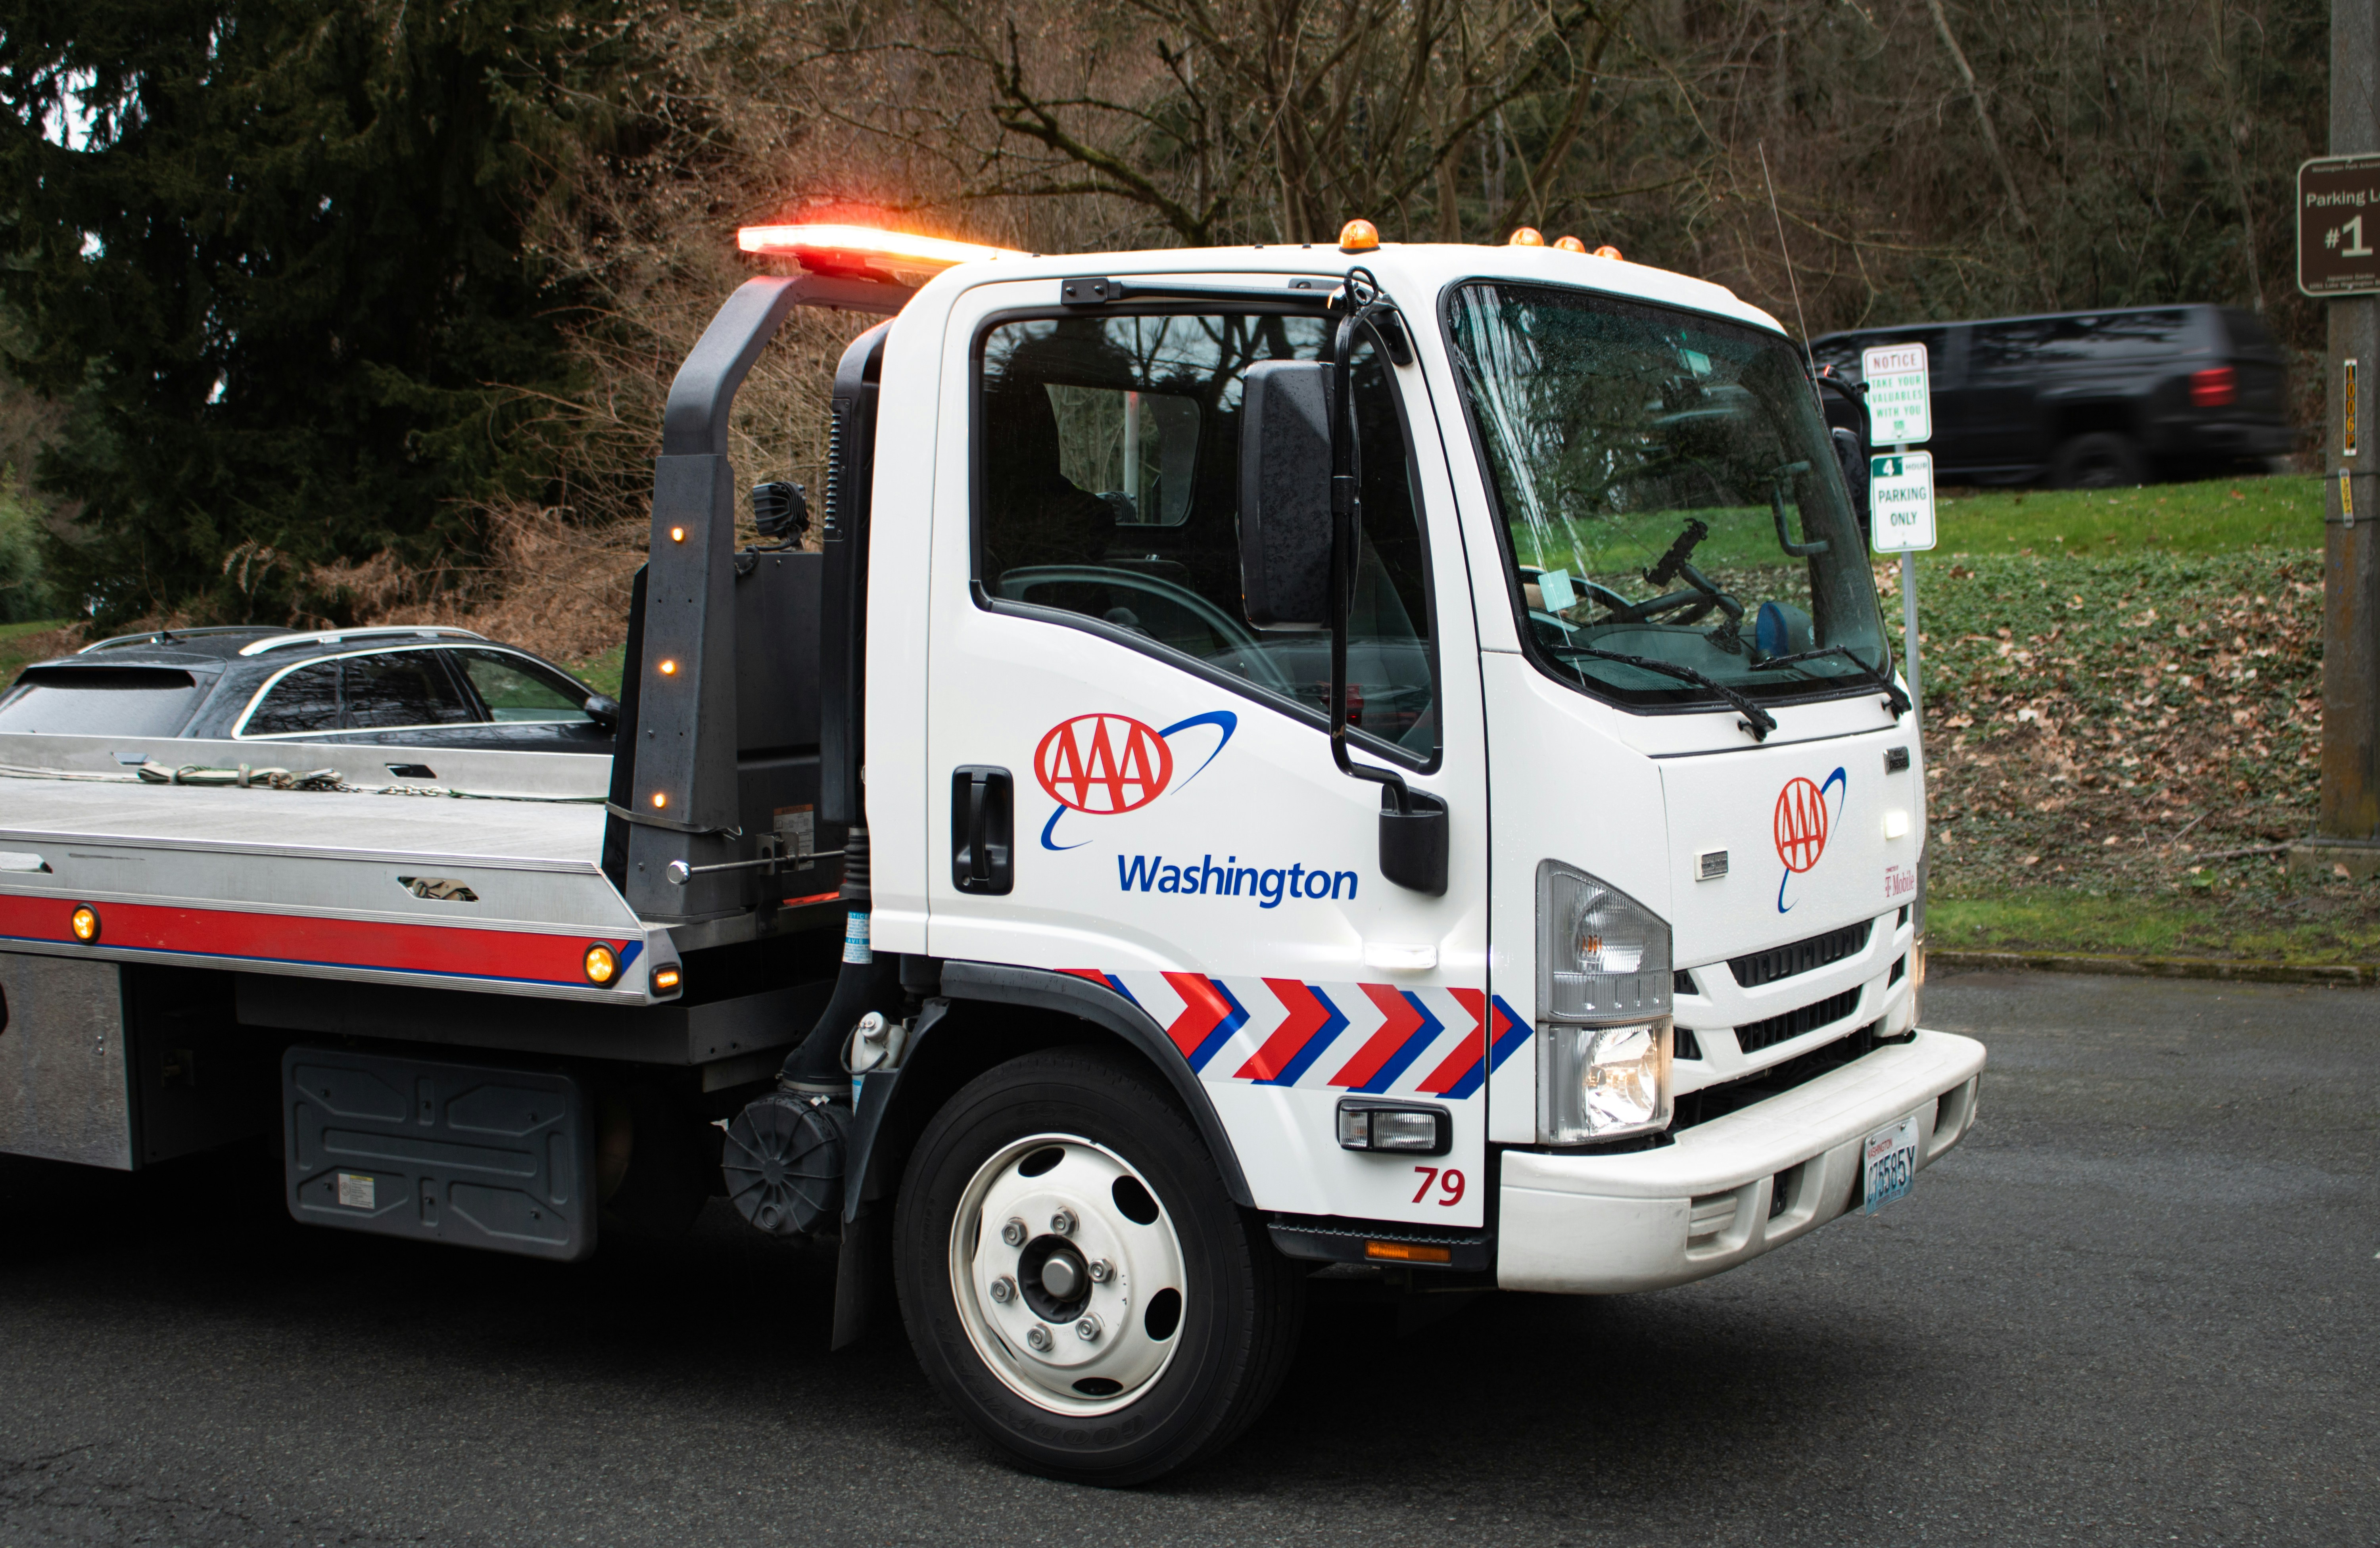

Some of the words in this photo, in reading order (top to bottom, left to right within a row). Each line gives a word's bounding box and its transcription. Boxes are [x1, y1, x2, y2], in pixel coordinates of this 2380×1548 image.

[2307, 188, 2366, 207] Parking
[2370, 187, 2380, 203] L
[2325, 214, 2373, 257] #1
[2340, 279, 2373, 288] Wahington
[1873, 353, 1916, 369] NOTICE
[1872, 378, 1892, 389] TAKE
[1898, 375, 1921, 386] YOUR
[1872, 389, 1923, 403] VALUABLES
[1877, 407, 1899, 418] WITH
[1904, 405, 1921, 416] YOU
[2346, 365, 2355, 449] 1006P
[1883, 459, 1894, 476] 4
[1905, 462, 1928, 471] HOUR
[1879, 487, 1927, 503] PARKING
[1891, 512, 1917, 526] ONLY
[1046, 714, 1162, 813] AAA
[1777, 779, 1827, 871] AAA
[1117, 854, 1358, 909] Washington
[1867, 1138, 1892, 1160] WASHINGTON
[1868, 1145, 1915, 1204] C75585Y
[1411, 1166, 1465, 1207] 79
[935, 1318, 1146, 1445] GOODYEAR
